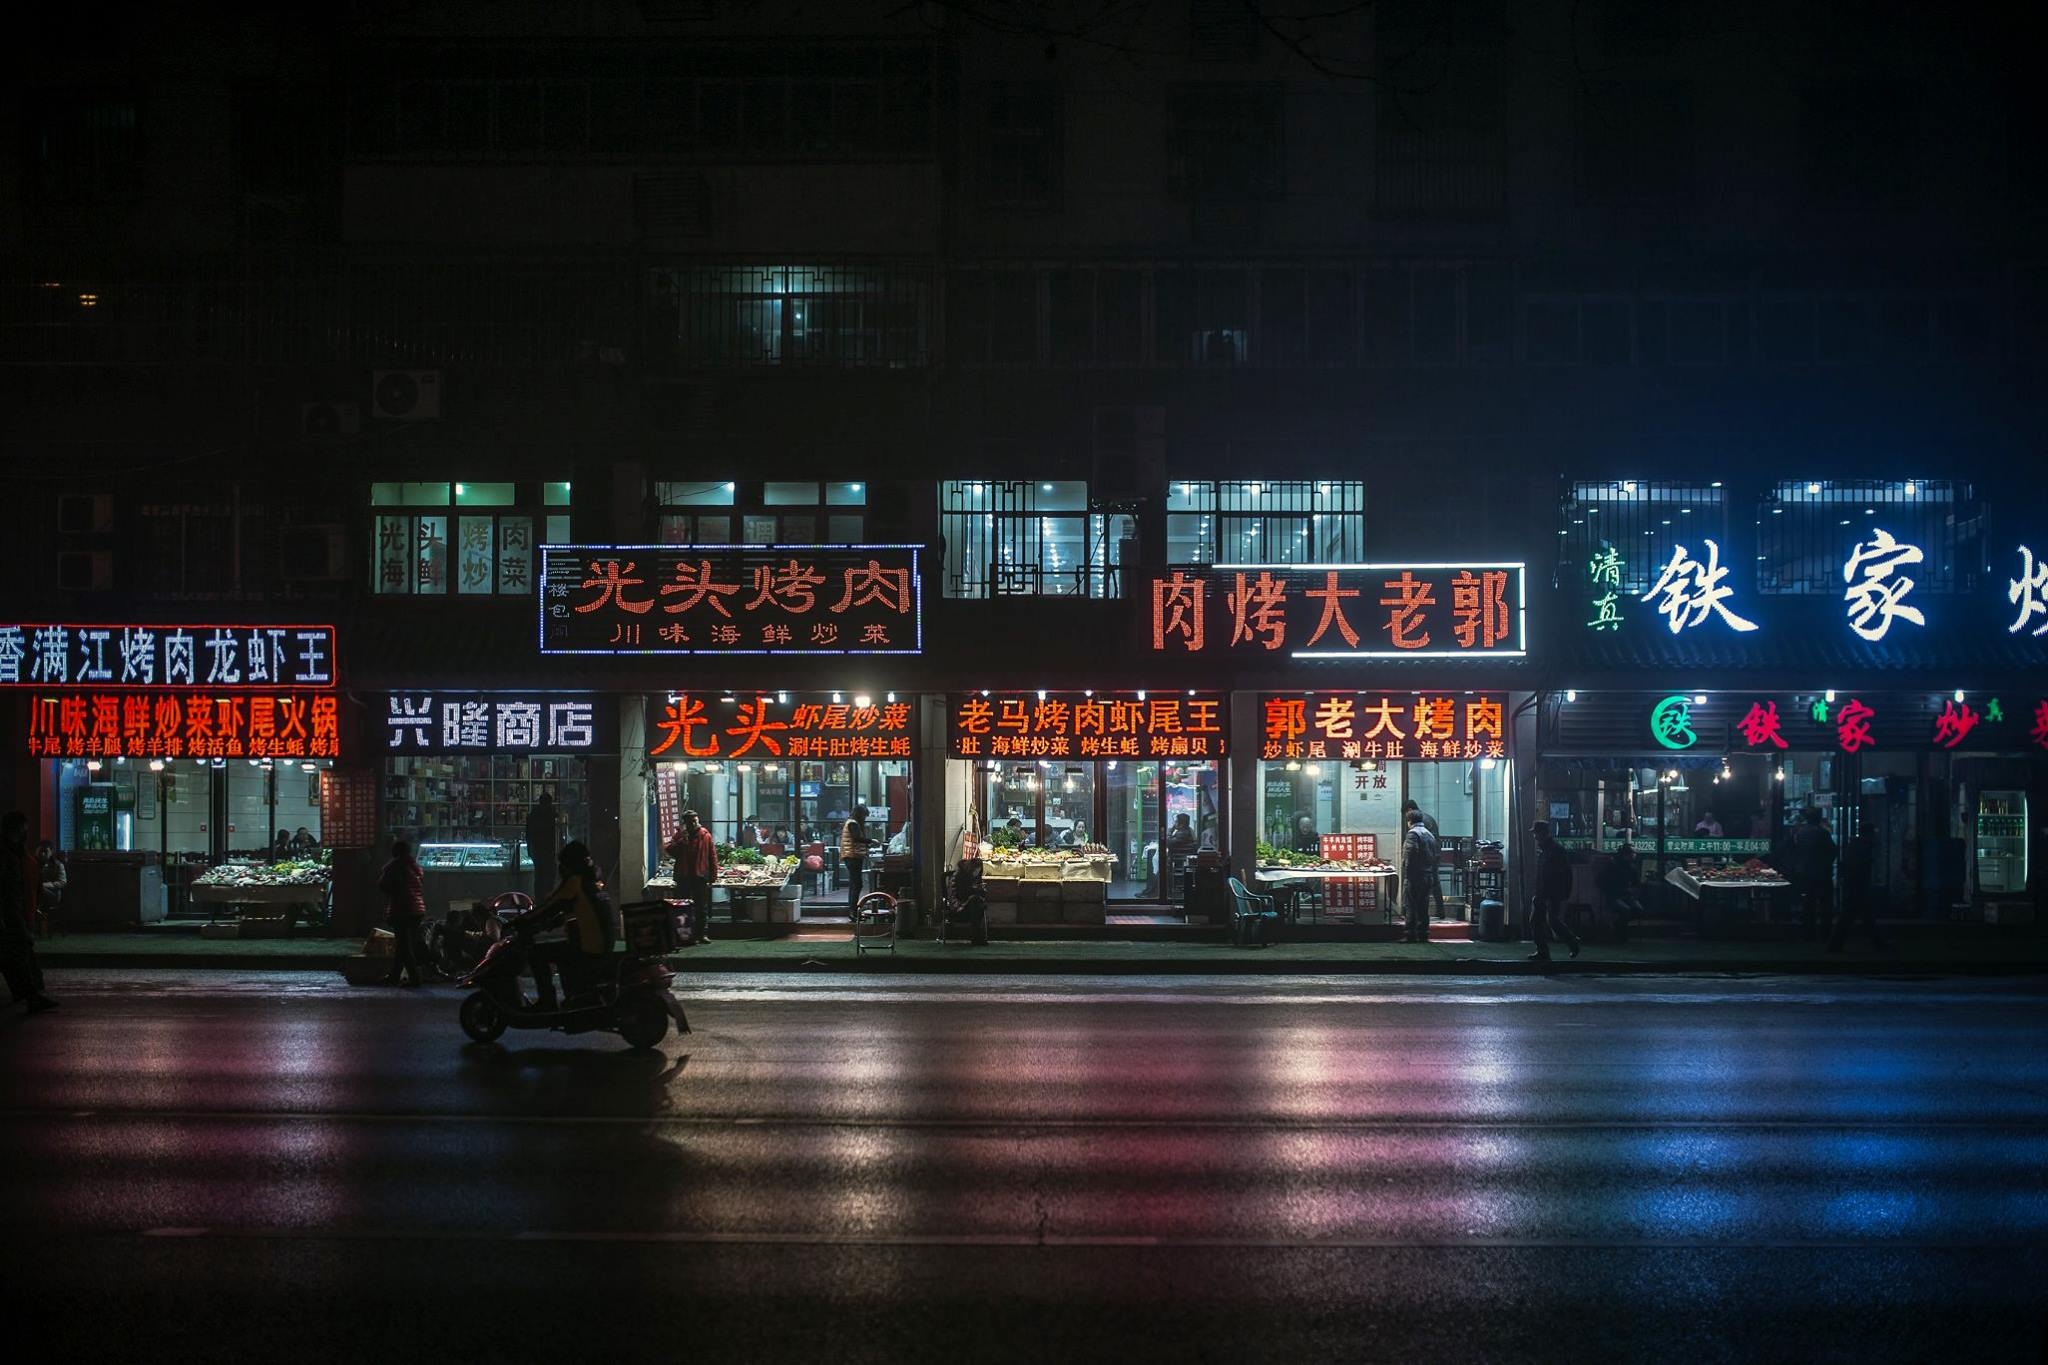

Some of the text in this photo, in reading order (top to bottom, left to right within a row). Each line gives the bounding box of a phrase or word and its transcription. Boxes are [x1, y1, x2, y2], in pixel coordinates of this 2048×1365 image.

[379, 521, 529, 551] 光头烤肉
[383, 556, 528, 589] 海鲜炒菜
[574, 560, 910, 616] 光头烤肉
[1588, 548, 1626, 631] 清真
[609, 622, 891, 645] 川味海鲜炒菜
[0, 626, 328, 684] 香满江烤肉龙虾王
[29, 694, 337, 738] 川味海鲜炒菜虾尾火锅
[387, 696, 593, 747] 兴隆商店
[650, 690, 789, 759] 光头
[789, 703, 912, 731] 虾尾炒菜
[958, 699, 1221, 736] 老马烤肉虾尾王
[1264, 697, 1503, 740] 郭老大烤肉
[67, 737, 121, 757] 烤羊腿
[128, 737, 183, 757] 烤羊排
[188, 738, 243, 757] 烤活鱼
[249, 738, 304, 757] 烤生蚝
[788, 736, 911, 758] 涮牛肚烤生蚝
[956, 736, 981, 756] 肚
[991, 735, 1070, 757] 海鲜炒菜
[1081, 736, 1140, 757] 烤生蚝
[1151, 736, 1208, 757] 烤扇贝
[1264, 740, 1505, 759] 炒虾尾 涮牛肚 海鲜炒菜
[1355, 774, 1387, 789] 开放
